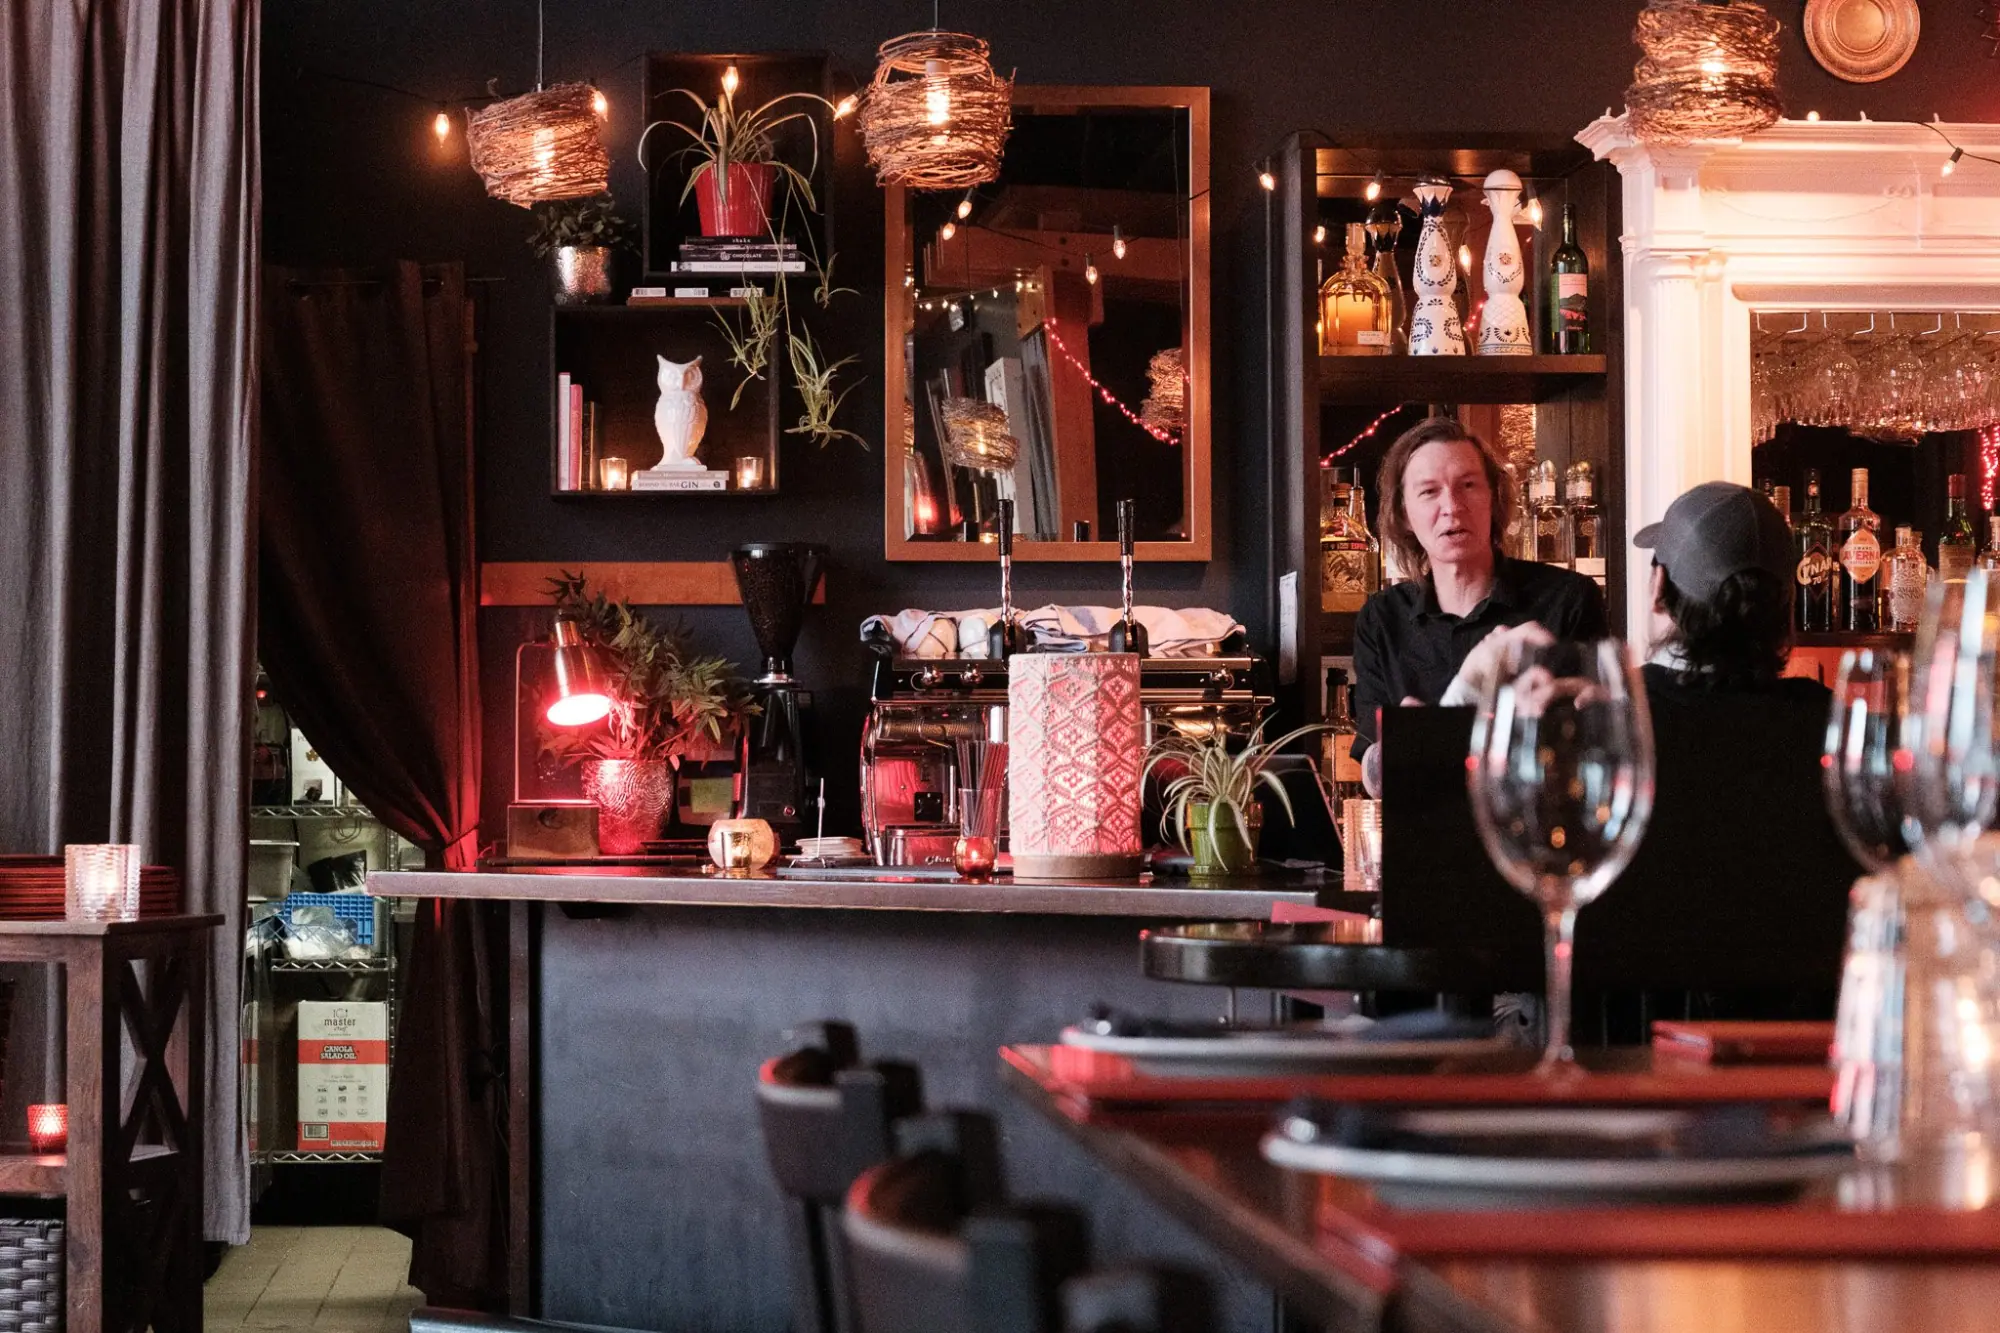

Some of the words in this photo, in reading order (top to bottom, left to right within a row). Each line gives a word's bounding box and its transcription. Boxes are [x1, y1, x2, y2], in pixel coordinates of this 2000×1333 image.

[1843, 550, 1880, 561] AVERNA
[324, 1018, 356, 1026] master
[323, 1045, 353, 1053] CANOLA
[320, 1052, 342, 1060] SALAD
[343, 1052, 357, 1060] OIL
